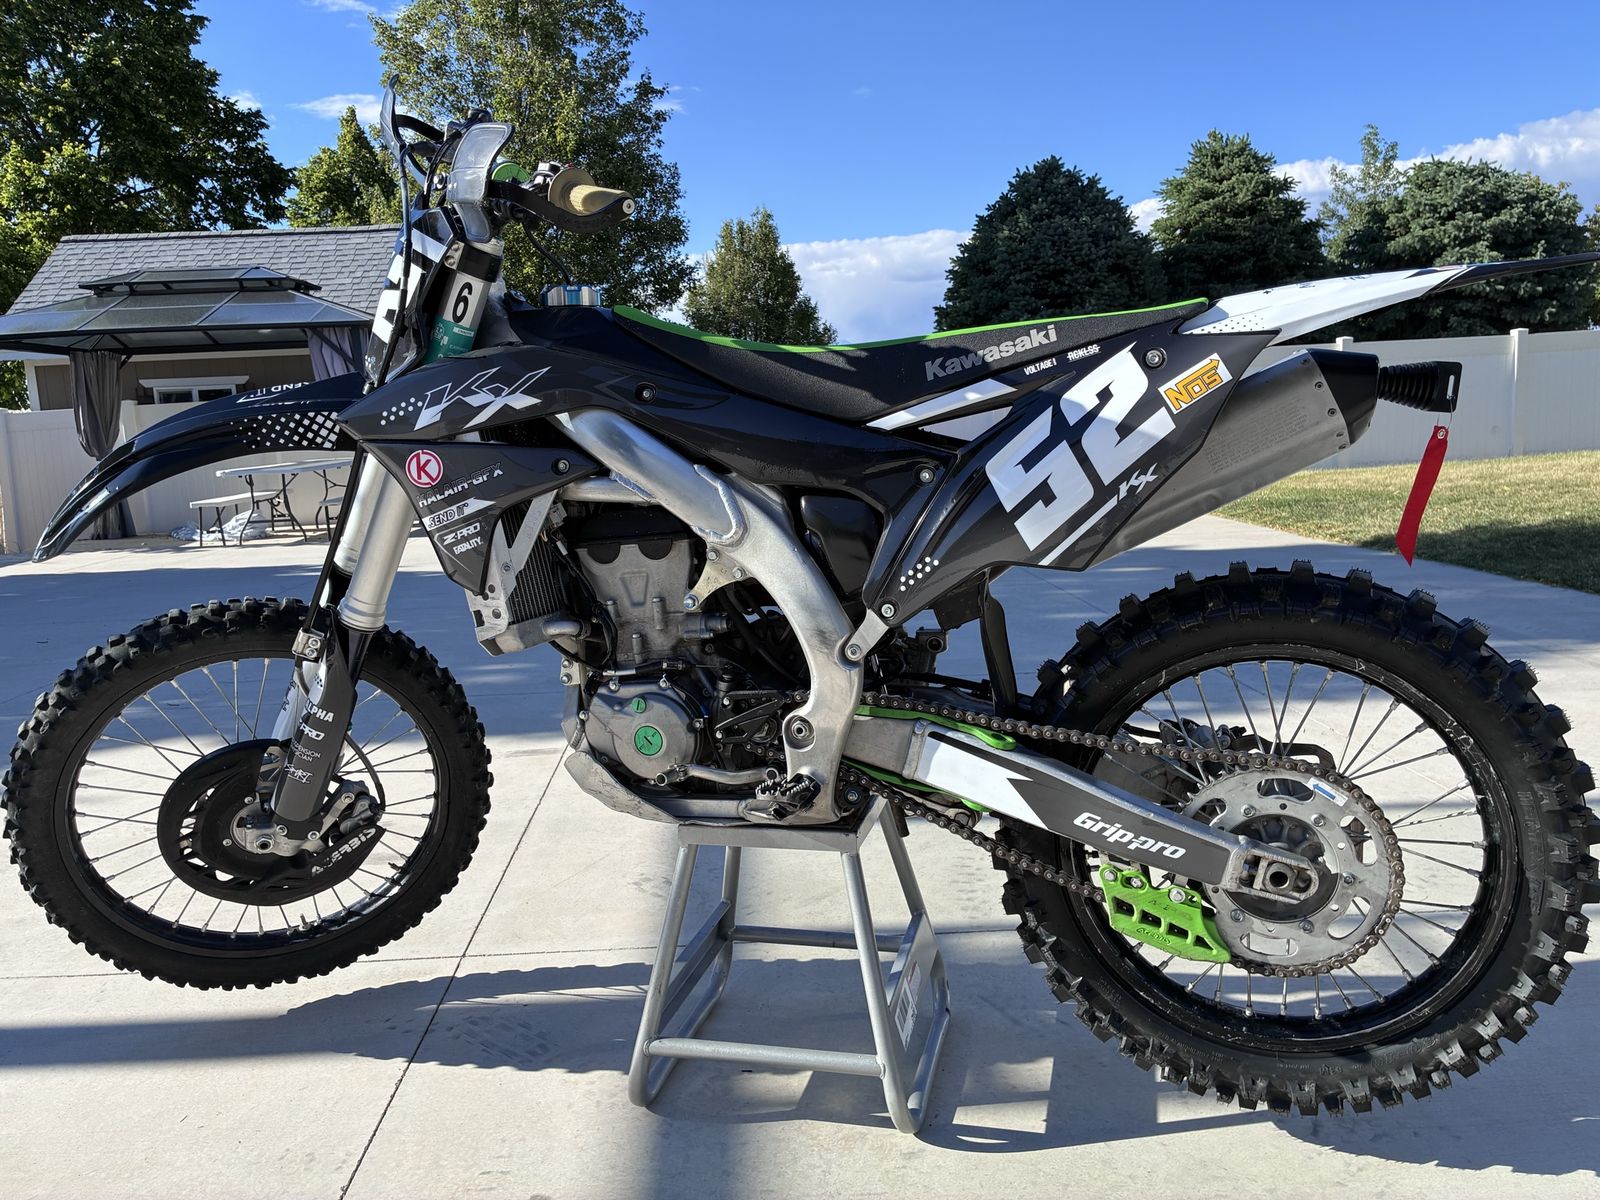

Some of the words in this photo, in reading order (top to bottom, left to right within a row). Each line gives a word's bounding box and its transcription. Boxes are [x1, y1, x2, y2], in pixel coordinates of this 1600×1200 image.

[452, 281, 473, 323] 6
[925, 324, 1057, 381] Kawasaki
[414, 366, 552, 431] KX
[1164, 358, 1223, 411] NOS
[985, 341, 1176, 551] 52
[1118, 463, 1158, 501] KX
